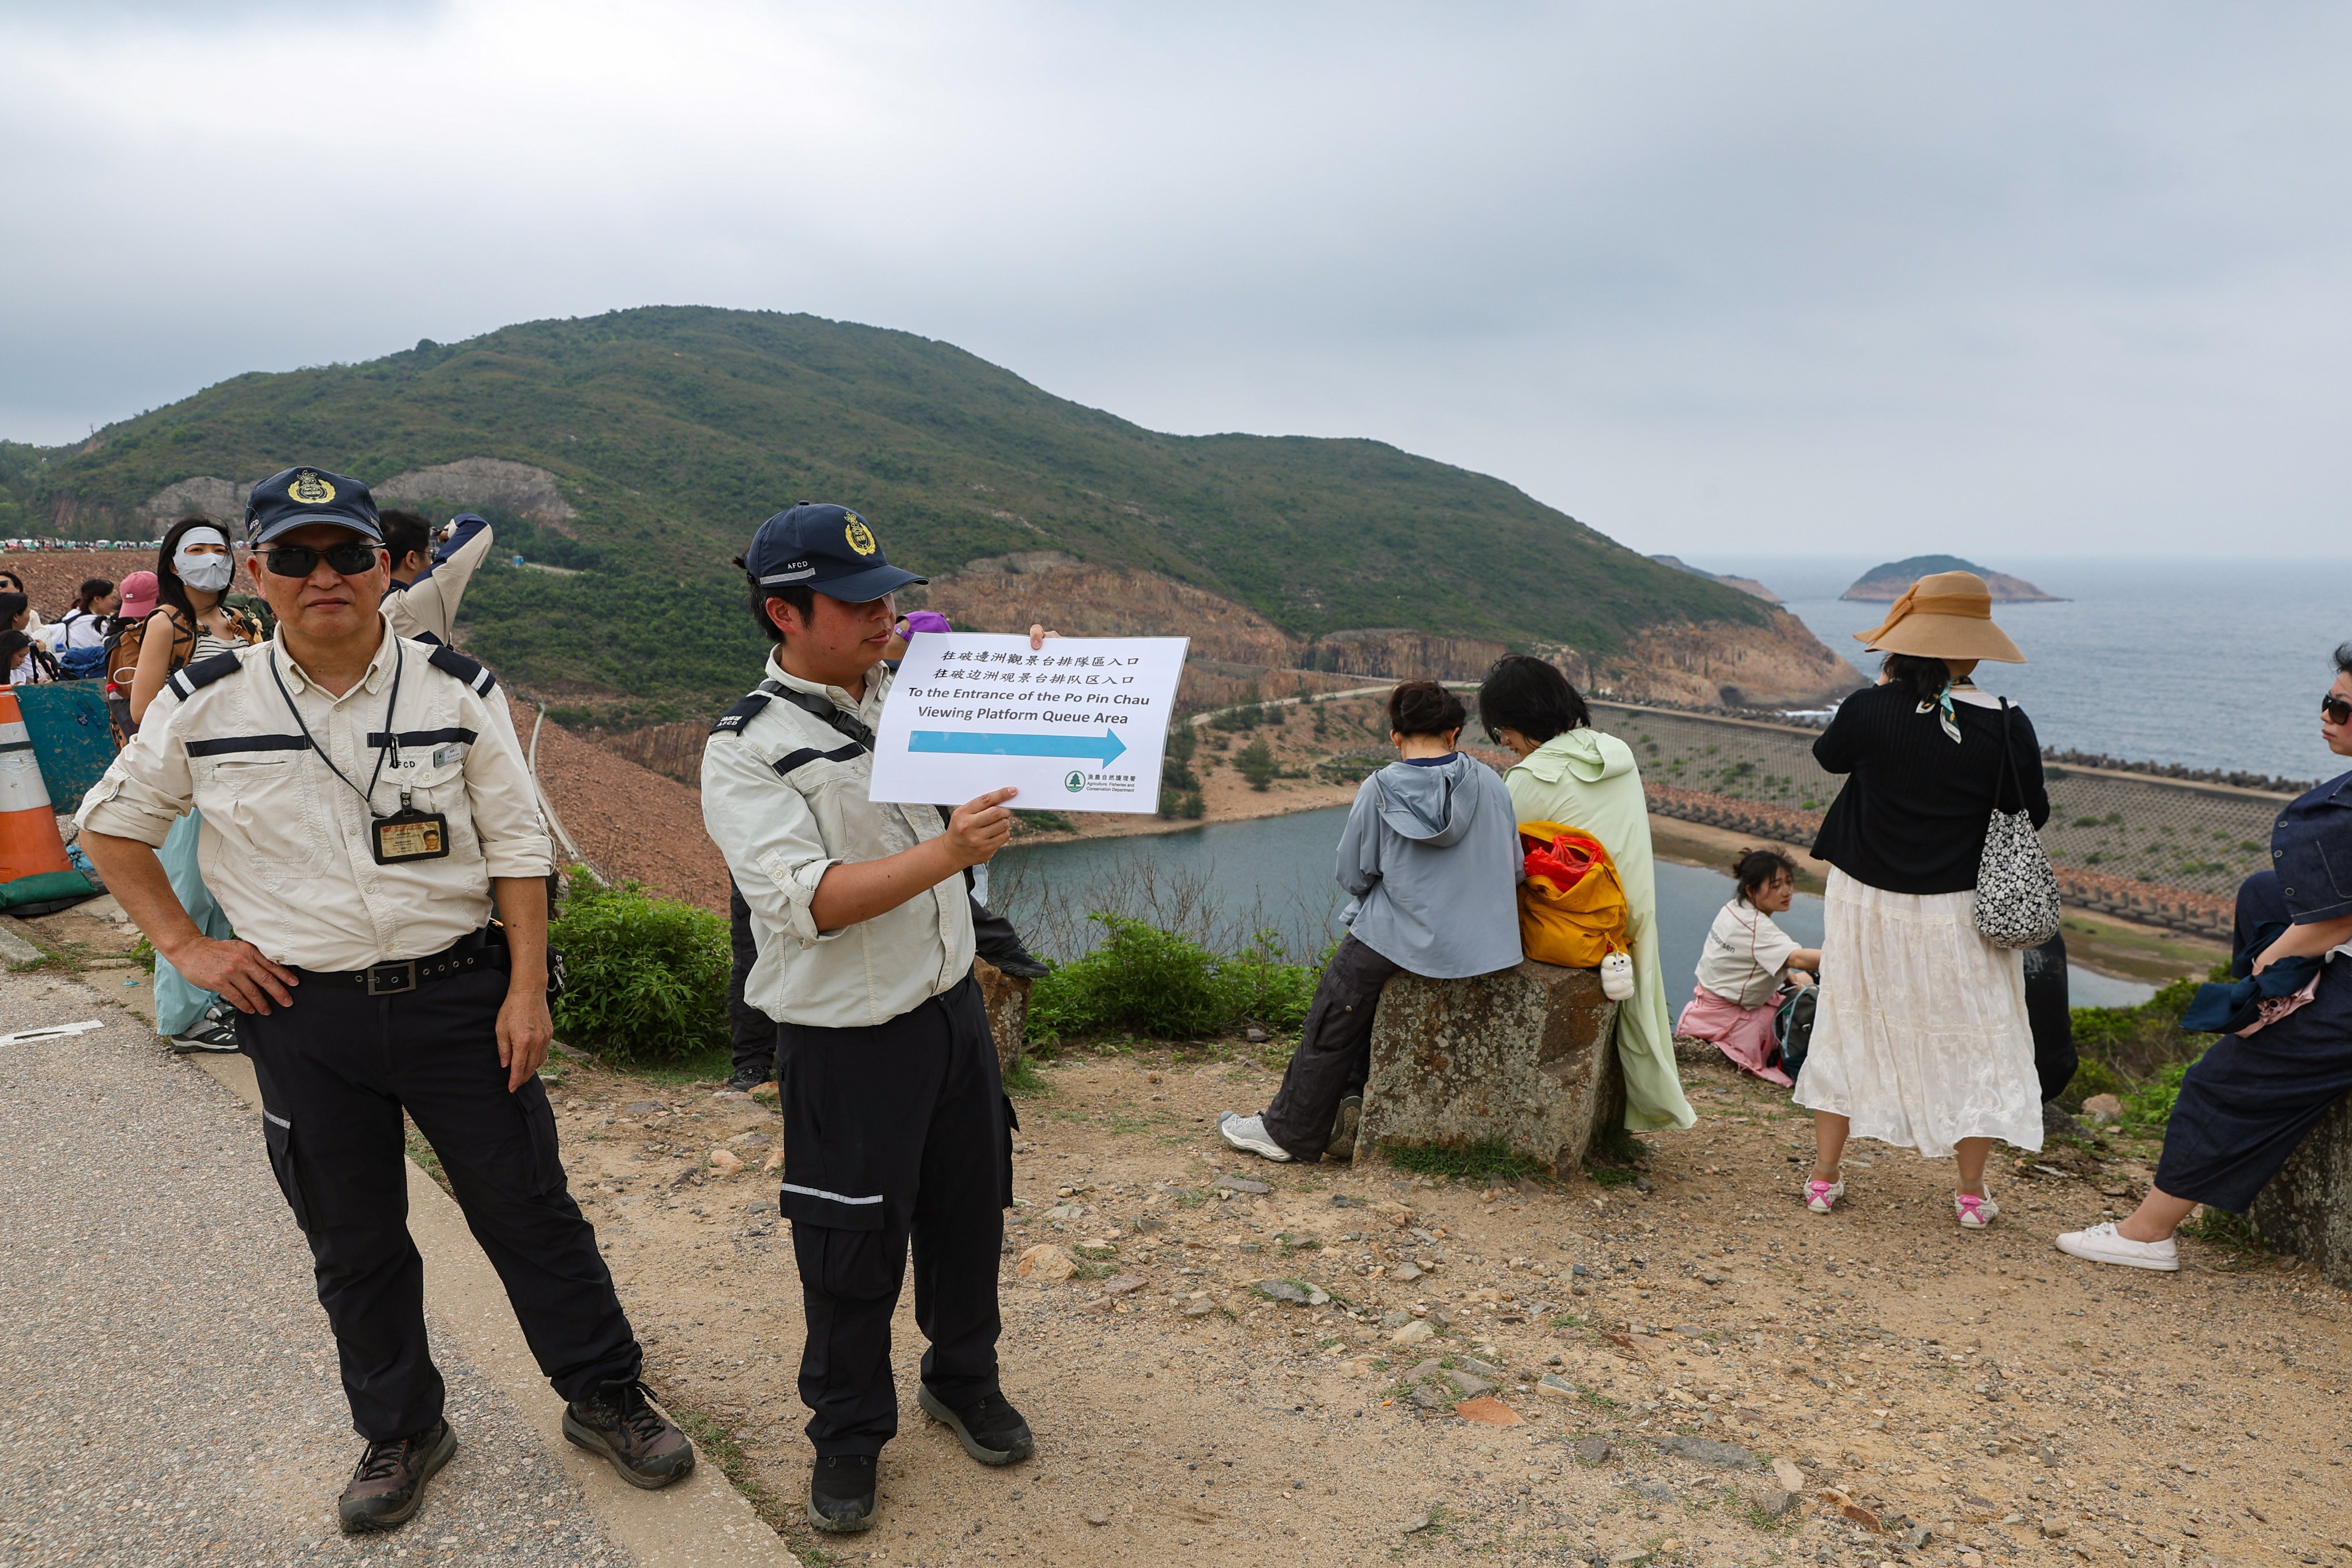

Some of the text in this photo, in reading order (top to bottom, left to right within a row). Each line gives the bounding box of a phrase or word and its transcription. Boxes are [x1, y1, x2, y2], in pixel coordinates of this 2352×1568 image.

[787, 561, 808, 569] AFCD
[940, 650, 1140, 667] 往破邊洲觀景台排隊區入口
[933, 668, 1134, 685] 往破边洲观景台排队区入口
[909, 687, 1150, 705] To the Entrance of the Po Pin Chau
[918, 706, 1128, 724] Viewing Platform Queue Area
[1087, 774, 1136, 782] 漁農自然護理署
